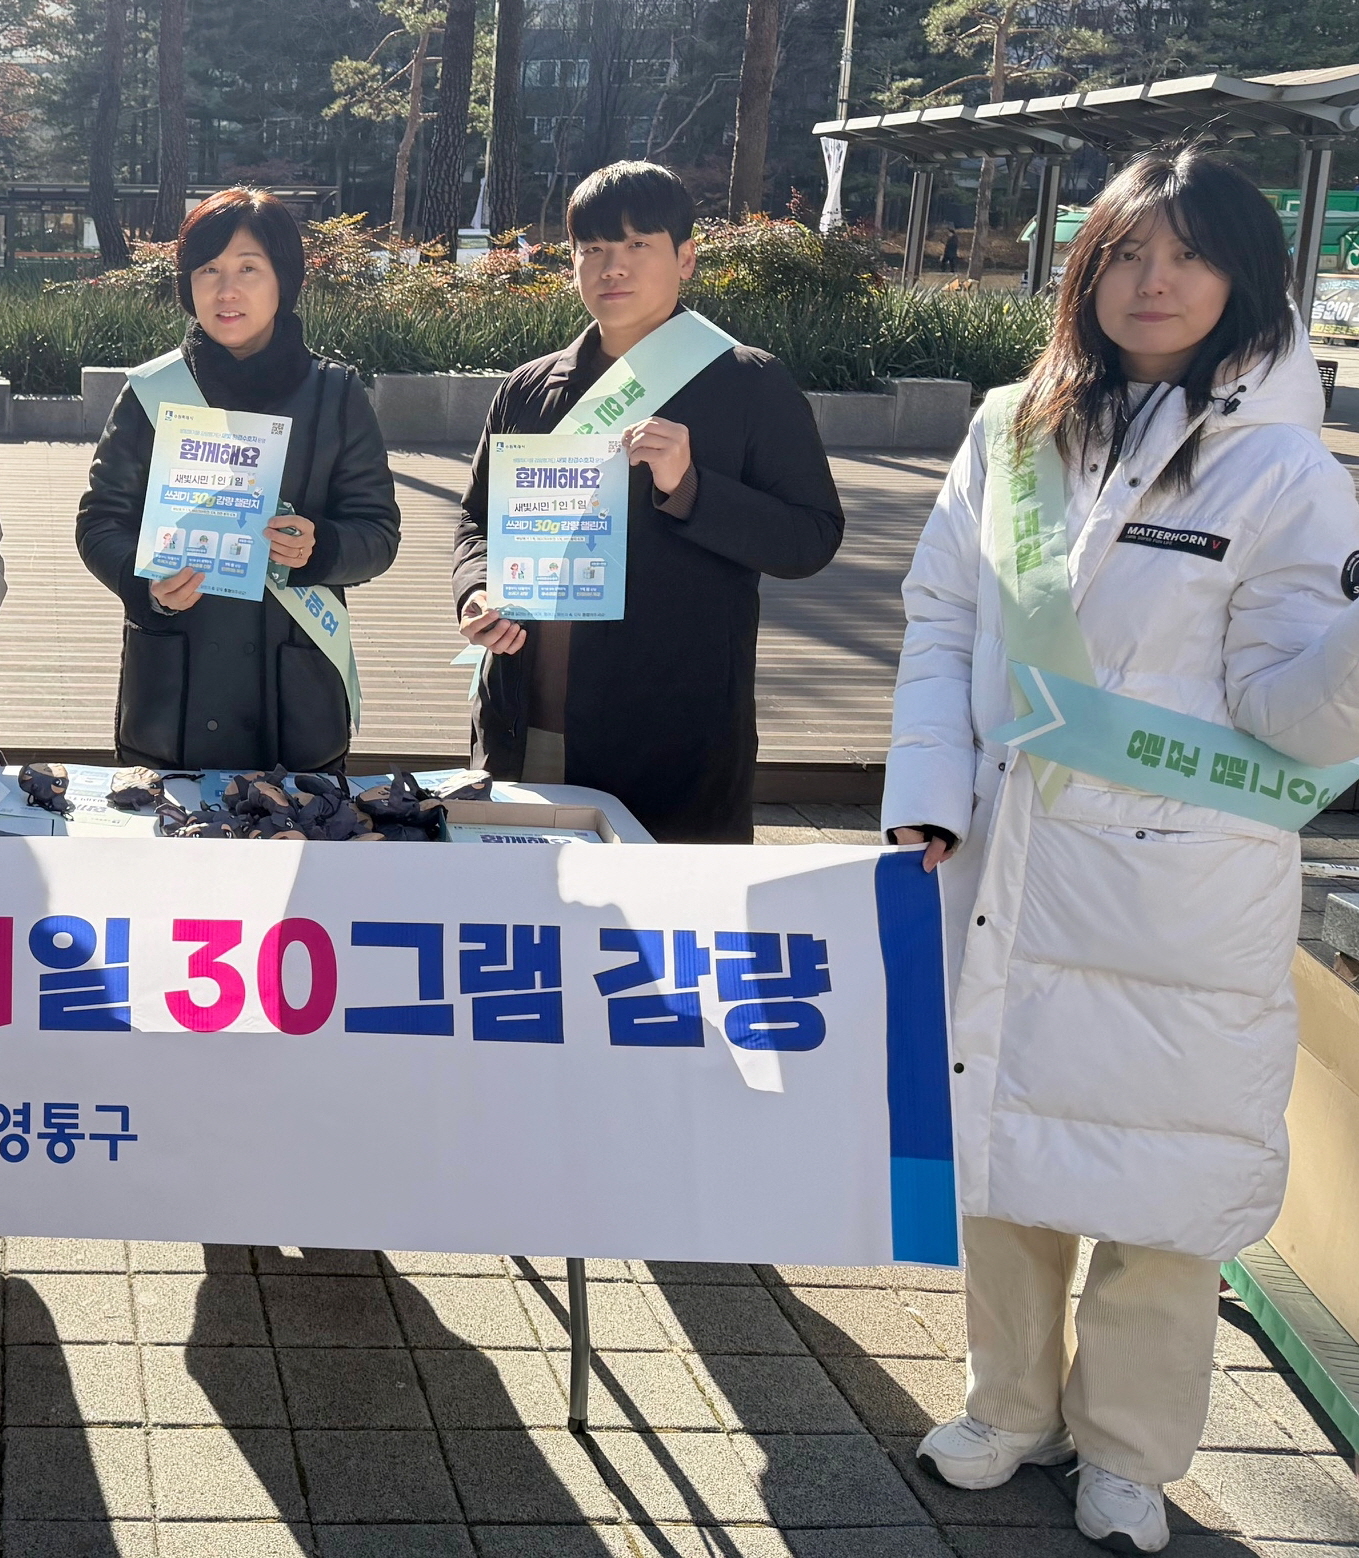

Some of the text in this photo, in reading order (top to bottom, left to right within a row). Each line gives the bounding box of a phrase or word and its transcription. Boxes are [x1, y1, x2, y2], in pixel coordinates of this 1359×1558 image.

[594, 376, 646, 427] 작은
[179, 438, 261, 468] 함께해요
[174, 473, 209, 485] 새빛시민
[211, 474, 226, 486] 1인
[516, 467, 601, 489] 함께해요
[164, 489, 190, 501] 쓰레기
[189, 491, 216, 508] 30g
[216, 495, 234, 506] 감량
[514, 501, 550, 512] 새빛시민
[551, 500, 568, 511] 1인
[506, 521, 532, 531] 쓰레기
[533, 520, 561, 534] 30g
[560, 521, 580, 531] 감량
[1127, 526, 1207, 547] MATTERHORN
[1127, 730, 1200, 778] 감량
[164, 917, 565, 1044] 30그램
[593, 927, 832, 1051] 감량
